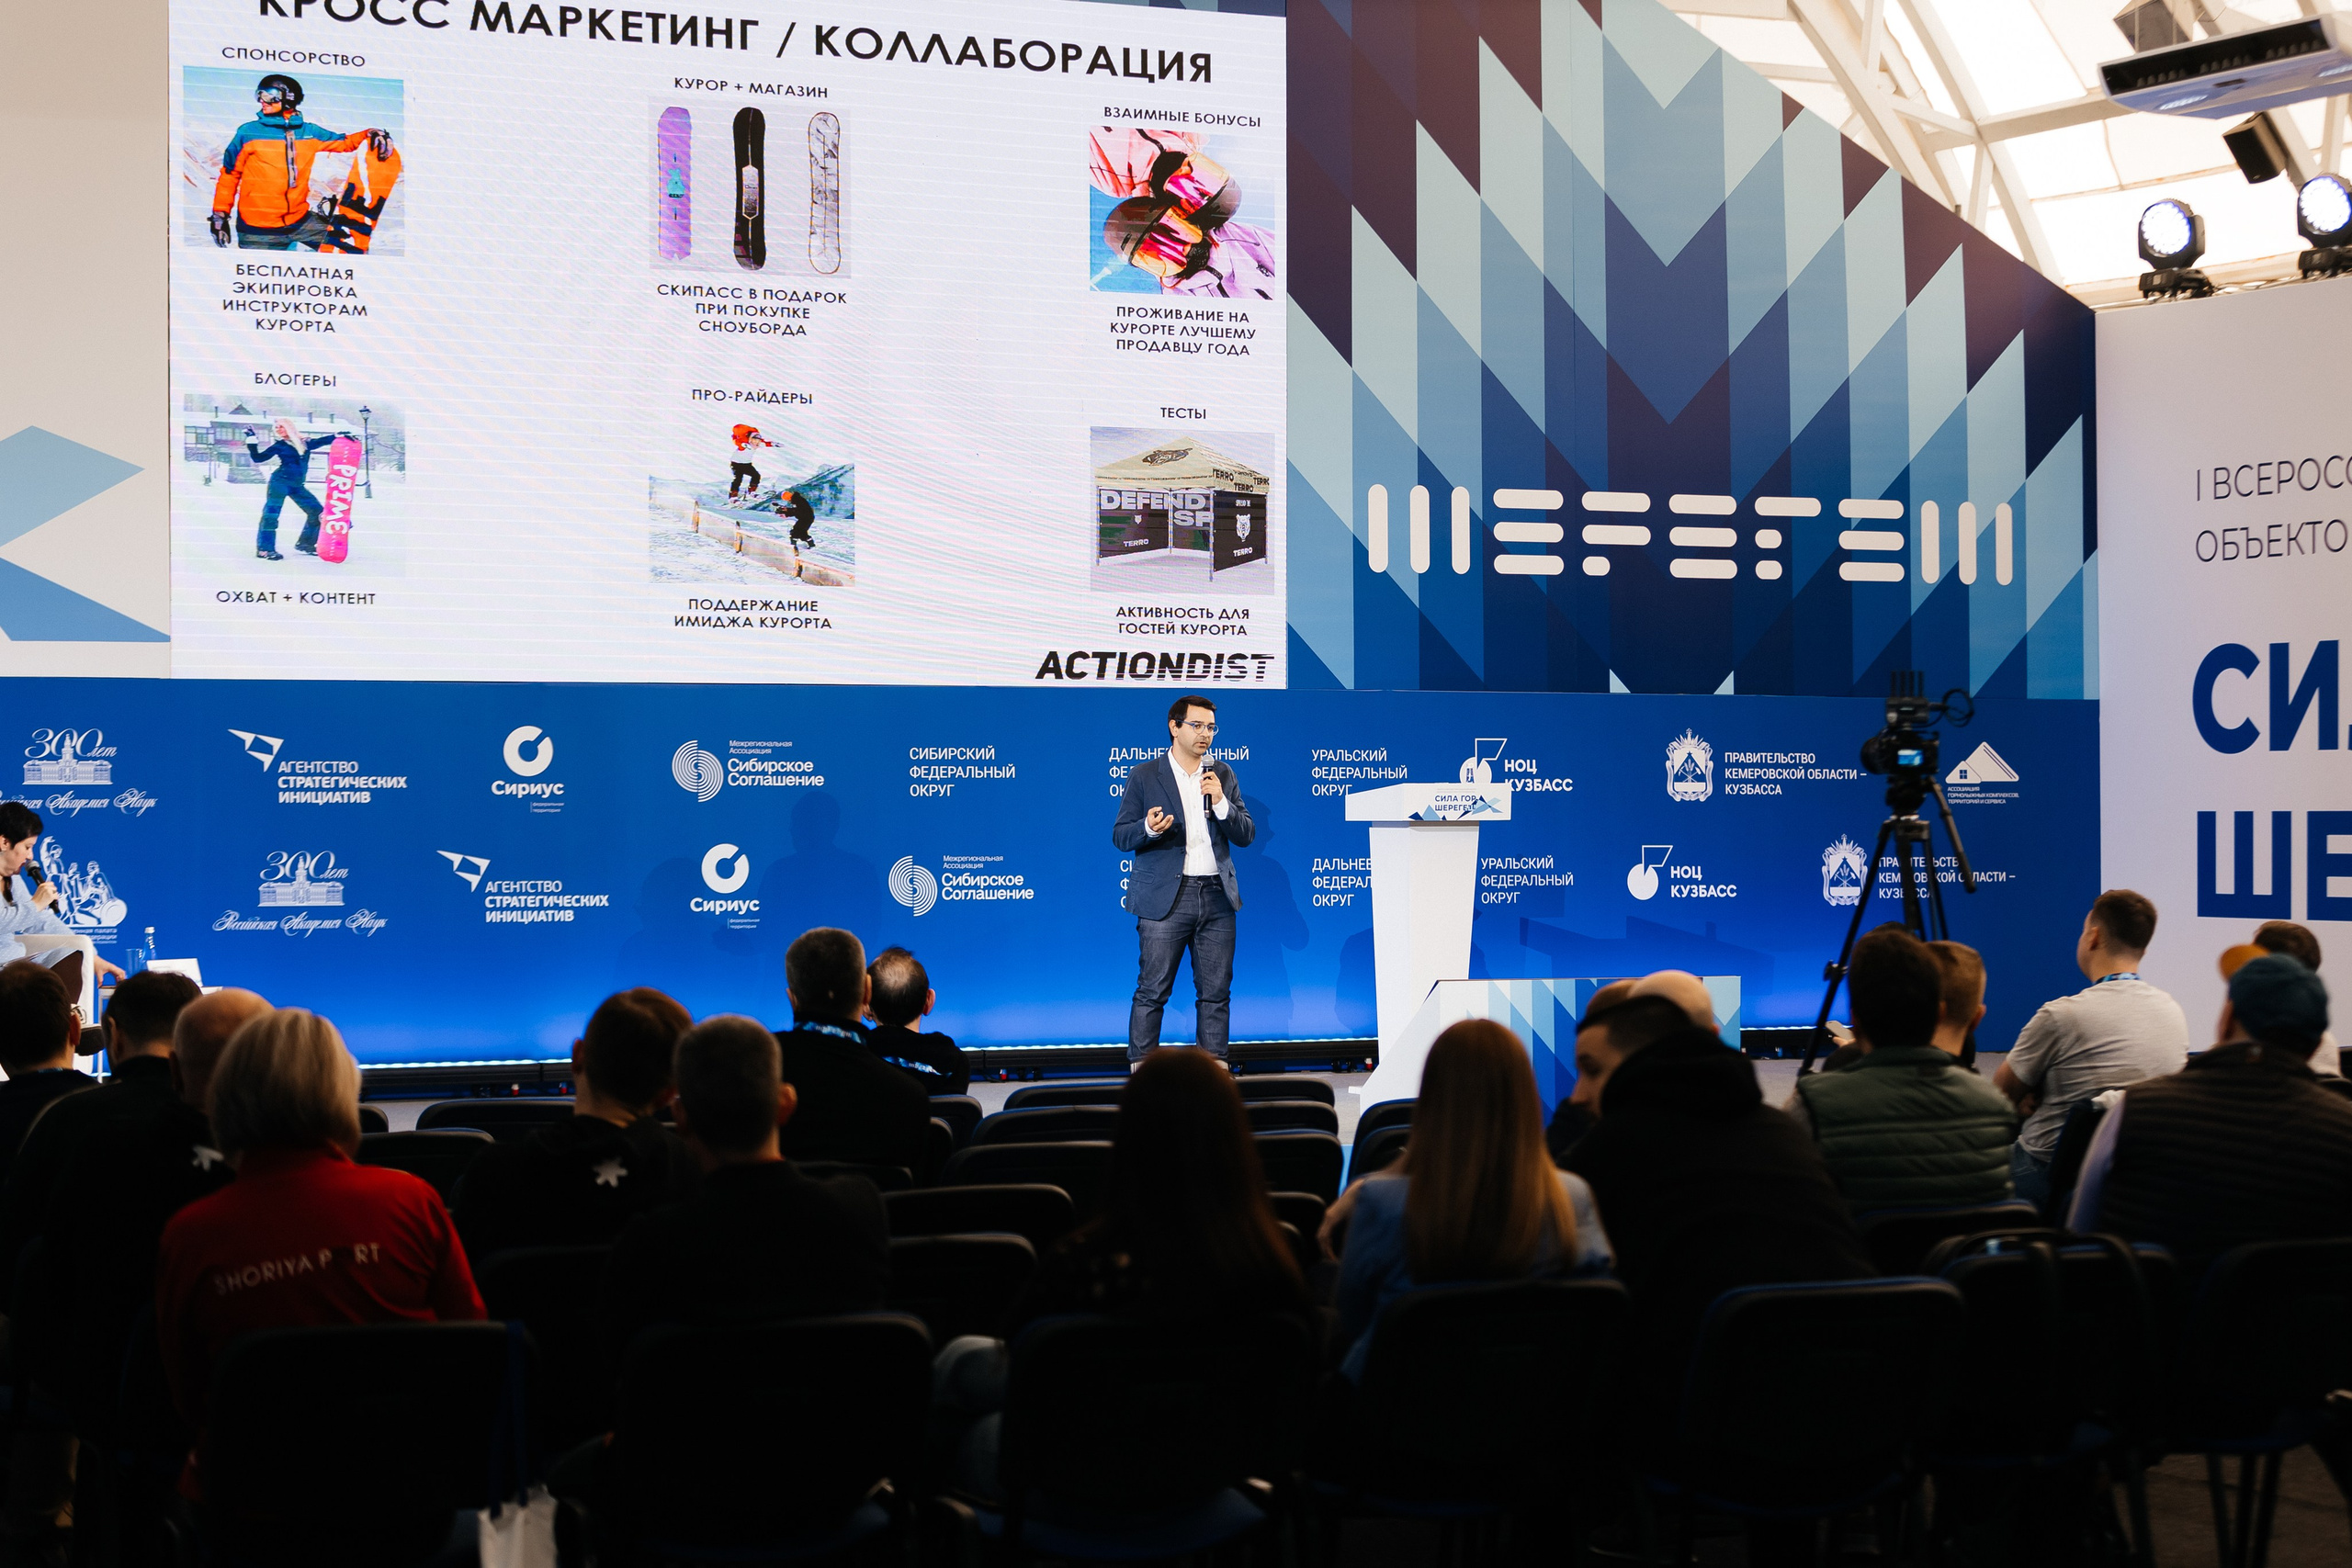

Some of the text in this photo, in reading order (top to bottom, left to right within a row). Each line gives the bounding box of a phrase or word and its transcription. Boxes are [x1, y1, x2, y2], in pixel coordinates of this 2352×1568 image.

[469, 3, 759, 51] МАРКЕТИНГ
[815, 24, 1212, 85] КОЛЛАБОРАЦИЯ
[221, 46, 366, 67] СПОНСОРСТВО
[674, 77, 729, 92] КУРОР
[749, 82, 828, 98] МАГАЗИН
[1103, 106, 1261, 128] ВЗАИМНЫЕ БОНУСЫ
[234, 263, 356, 282] БЕСПЛАТНАЯ
[232, 281, 357, 299] ЭКИПИРОВКА
[657, 284, 847, 304] СКИПАСС В ПОДАРОК
[222, 299, 368, 317] ИНСТРУКТОРАМ
[695, 302, 810, 321] ПРИ ПОКУПКЕ
[1115, 305, 1250, 323] ПРОЖИВАНИЕ НА
[255, 318, 335, 333] КУРОРТА
[697, 319, 808, 338] СНОУБОРДА
[1110, 321, 1257, 340] КУРОРТЕ ЛУЧШЕМУ
[1115, 339, 1250, 357] ПРОДАВЦУ ГОДА
[254, 372, 336, 387] БЛОГЕРЫ
[692, 389, 813, 405] ПРО-РАЙДЕРЫ
[1159, 407, 1206, 420] ТЕСТЫ
[1213, 468, 1234, 482] TERRO
[1234, 482, 1254, 492] TERRO
[325, 464, 358, 535] PRIME
[1100, 489, 1206, 511] DEFEND
[1123, 538, 1149, 547] TERRO
[1233, 547, 1253, 557] TERRO
[216, 591, 277, 604] ОХВАТ
[300, 592, 376, 605] КОНТЕНТ
[688, 598, 819, 613] ПОДДЕРЖАНИЕ
[1115, 605, 1250, 621] АКТИВНОСТЬ ДЛЯ
[674, 615, 832, 629] ИМИДЖА КУРОРТА
[1118, 621, 1248, 636] ГОСТЕЙ КУРОРТА
[1035, 649, 1276, 682] ACTIONDIST
[2192, 639, 2352, 755] СИ
[24, 728, 118, 759] 300 лет
[729, 739, 793, 748] Межрегиональная
[909, 744, 995, 761] СИБИРСКИЙ
[1311, 747, 1387, 762] УРАЛЬСКИЙ
[1724, 751, 1816, 764] ПРАВИТЕЛЬСТВО
[277, 760, 359, 775] АГЕНТСТВО
[727, 758, 814, 775] Сибирское
[909, 762, 1016, 782] ФЕДЕРАЛЬНЫЙ
[1311, 764, 1408, 782] ФЕДЕРАЛЬНЫЙ
[1504, 758, 1538, 775] НОЦ
[1724, 765, 1805, 780] КЕМЕРОВСКОЙ
[1806, 768, 1858, 780] ОБЛАСТИ
[277, 775, 408, 789] СТРАТЕГИЧЕСКИХ
[727, 772, 825, 786] Соглашение
[1504, 778, 1574, 793] КУЗБАСС
[491, 780, 565, 799] Сириус
[909, 784, 956, 797] ОКРУГ
[1312, 784, 1353, 796] ОКРУГ
[1724, 783, 1782, 795] КУЗБАССА
[45, 790, 110, 818] Академия
[277, 790, 372, 807] ИНИЦИАТИВ
[259, 850, 349, 881] 300 лет
[1480, 854, 1555, 870] УРАЛЬСКИЙ
[941, 872, 1024, 889] Сибирское
[1480, 871, 1574, 889] ФЕДЕРАЛЬНЫЙ
[1670, 865, 1703, 882] НОЦ
[1958, 872, 2007, 882] ОЛАСТИ
[484, 880, 563, 894] АГЕНТСТВО
[941, 886, 1035, 900] Соглашение
[1670, 884, 1737, 898] КУЗБАСС
[484, 893, 610, 908] СТРАТЕГИЧЕСКИХ
[689, 897, 761, 916] Сириус
[1312, 893, 1355, 908] ОКРУГ
[1481, 891, 1521, 905] ОКРУГ
[279, 911, 343, 939] Академия
[485, 908, 575, 925] ИНИЦИАТИВ
[213, 1242, 379, 1296] SHORIYA PRT
